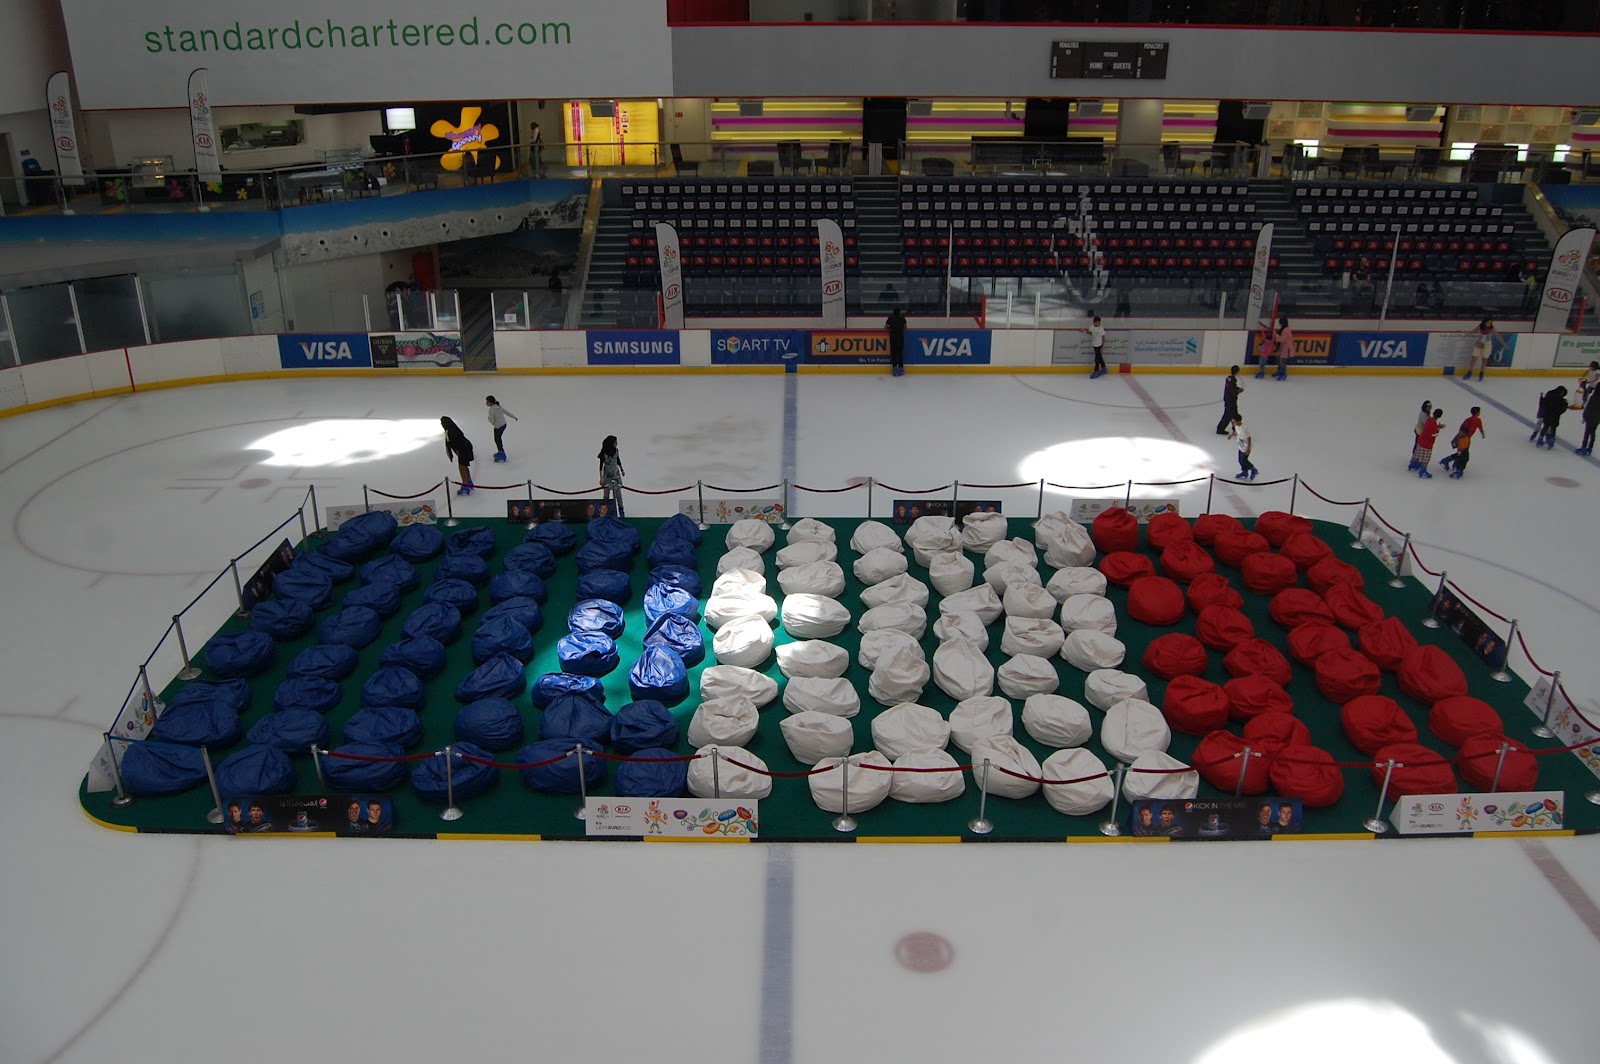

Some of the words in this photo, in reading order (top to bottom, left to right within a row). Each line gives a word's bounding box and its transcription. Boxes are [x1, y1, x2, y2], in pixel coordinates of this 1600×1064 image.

[144, 17, 572, 53] standardchartered.com
[60, 139, 72, 148] KIA
[197, 136, 211, 145] KIA
[1550, 290, 1568, 300] KIA
[300, 341, 352, 360] VISA
[593, 341, 674, 354] SAMSUNG
[773, 339, 791, 351] TV
[832, 338, 887, 352] JOTUN
[919, 337, 972, 357] VISA
[1273, 339, 1327, 353] JTUN
[1358, 340, 1408, 359] VISA
[1576, 340, 1595, 348] good
